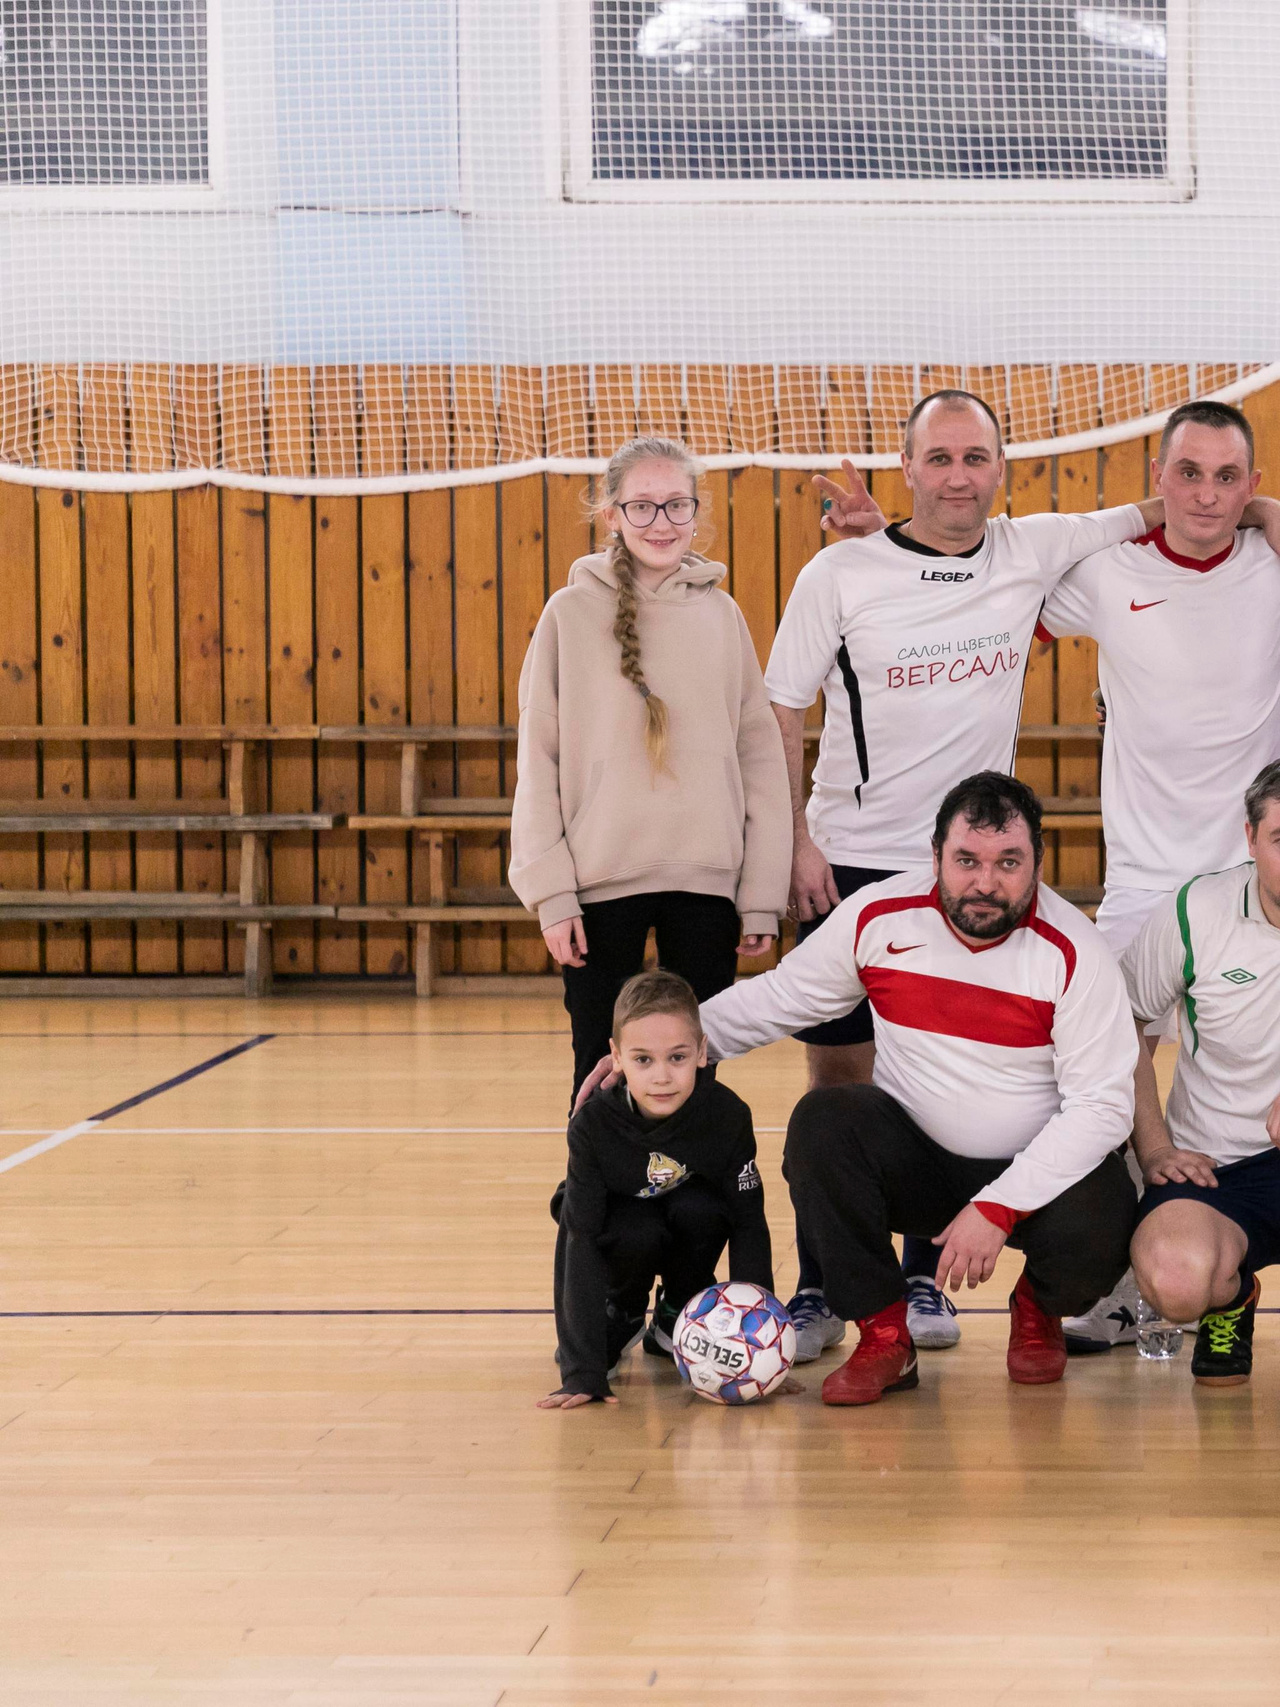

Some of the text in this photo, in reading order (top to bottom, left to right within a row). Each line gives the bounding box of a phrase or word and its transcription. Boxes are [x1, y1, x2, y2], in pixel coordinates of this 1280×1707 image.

[921, 570, 974, 582] LEGEA
[897, 632, 1011, 660] САЛОН ЦВЕТОВ
[887, 648, 1020, 688] ВЕРСАЛЬ
[683, 1331, 745, 1369] SELECT
